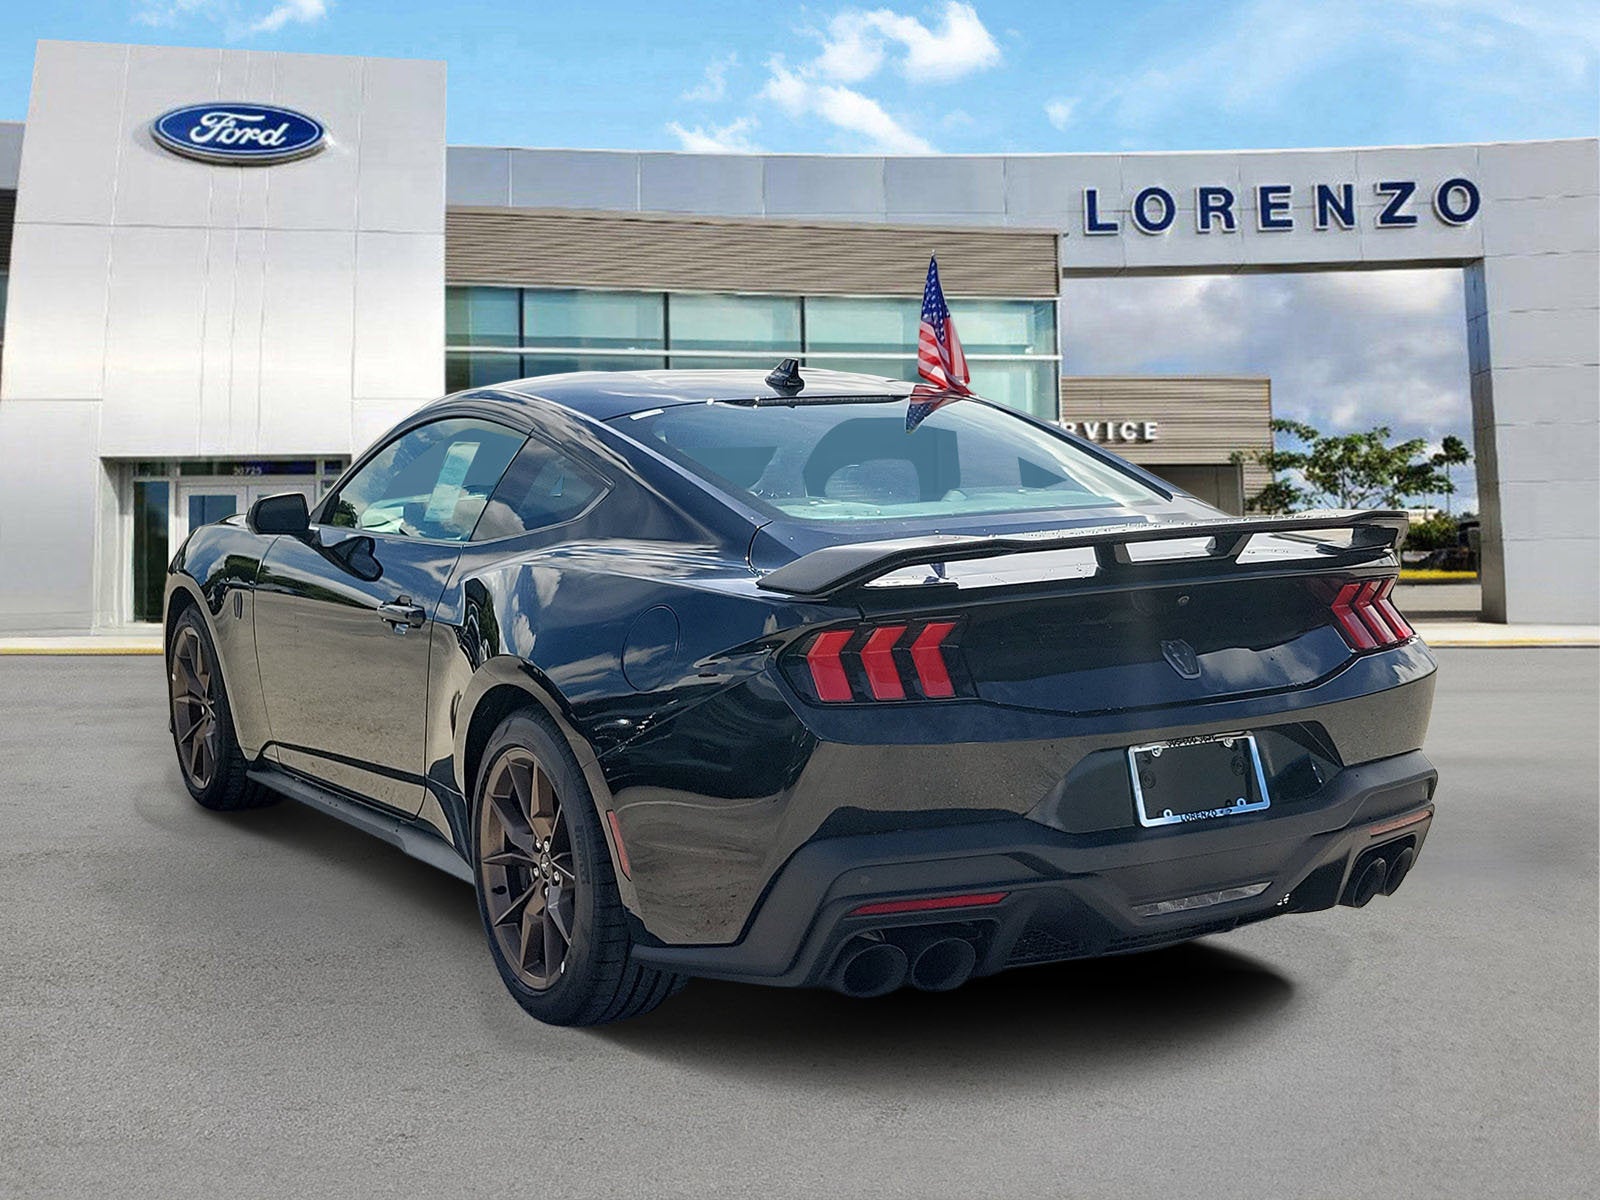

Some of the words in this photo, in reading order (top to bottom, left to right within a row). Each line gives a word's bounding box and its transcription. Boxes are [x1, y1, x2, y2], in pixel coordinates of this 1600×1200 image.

[190, 111, 290, 147] Ford
[1083, 176, 1481, 236] LORENZO
[1180, 808, 1218, 822] LORENZO
